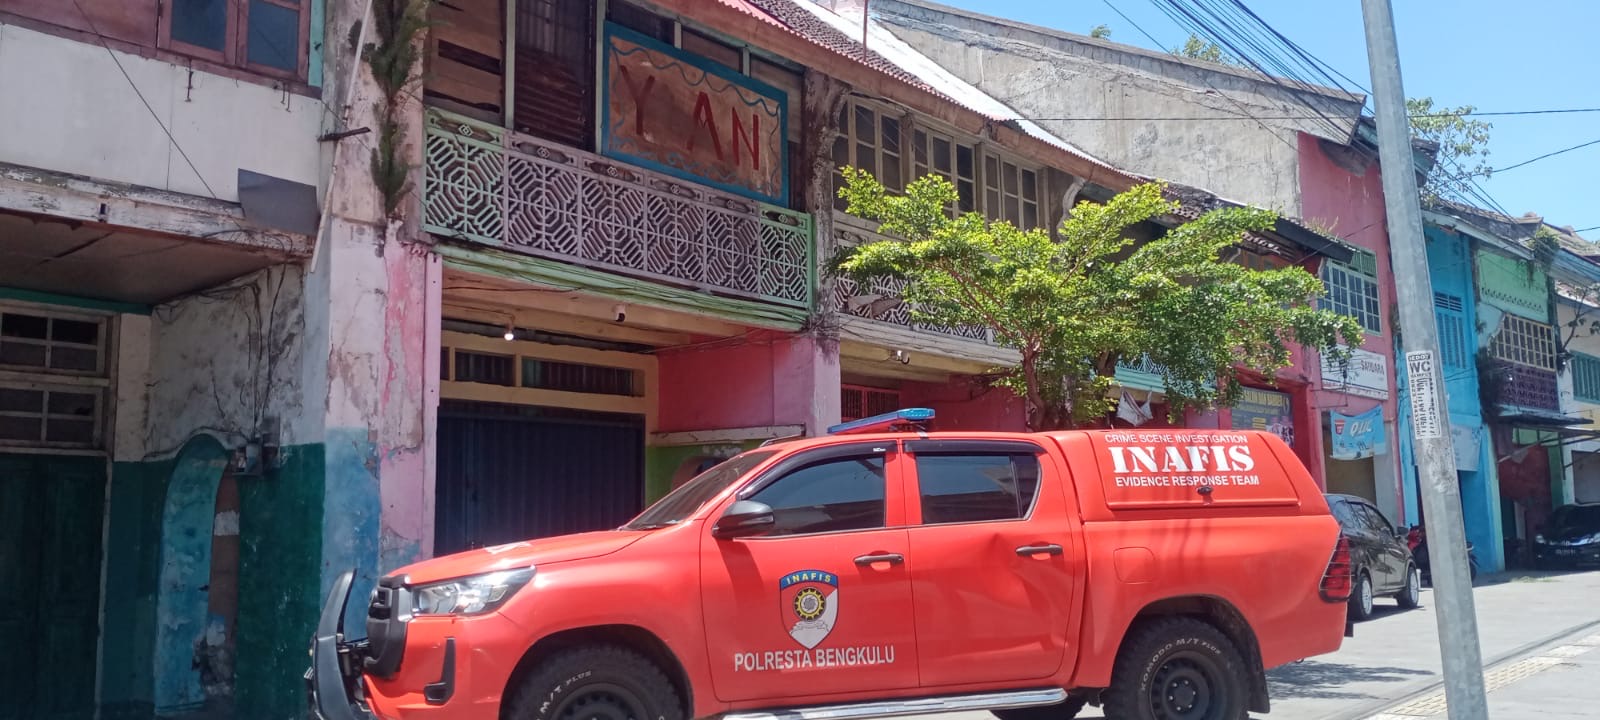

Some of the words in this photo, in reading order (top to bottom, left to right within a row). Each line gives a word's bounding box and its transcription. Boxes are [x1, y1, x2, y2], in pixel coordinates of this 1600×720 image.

[1410, 361, 1431, 373] WC
[1104, 434, 1138, 443] CRIME
[1139, 434, 1173, 443] SCENE
[1175, 434, 1248, 443] INVESTIGATION
[1108, 445, 1255, 473] INAFIS
[1115, 476, 1170, 487] EVIDENCE
[1172, 475, 1229, 487] RESPONSE
[1231, 475, 1260, 486] TEAM
[786, 572, 831, 585] INAFIS
[734, 650, 812, 672] POLRESTA
[815, 645, 895, 667] BENGKULU
[1140, 643, 1173, 691] KOMODO
[1175, 638, 1199, 646] M/T
[1201, 641, 1222, 655] PLUS
[540, 685, 562, 714] M/T
[565, 670, 592, 687] PLUS
